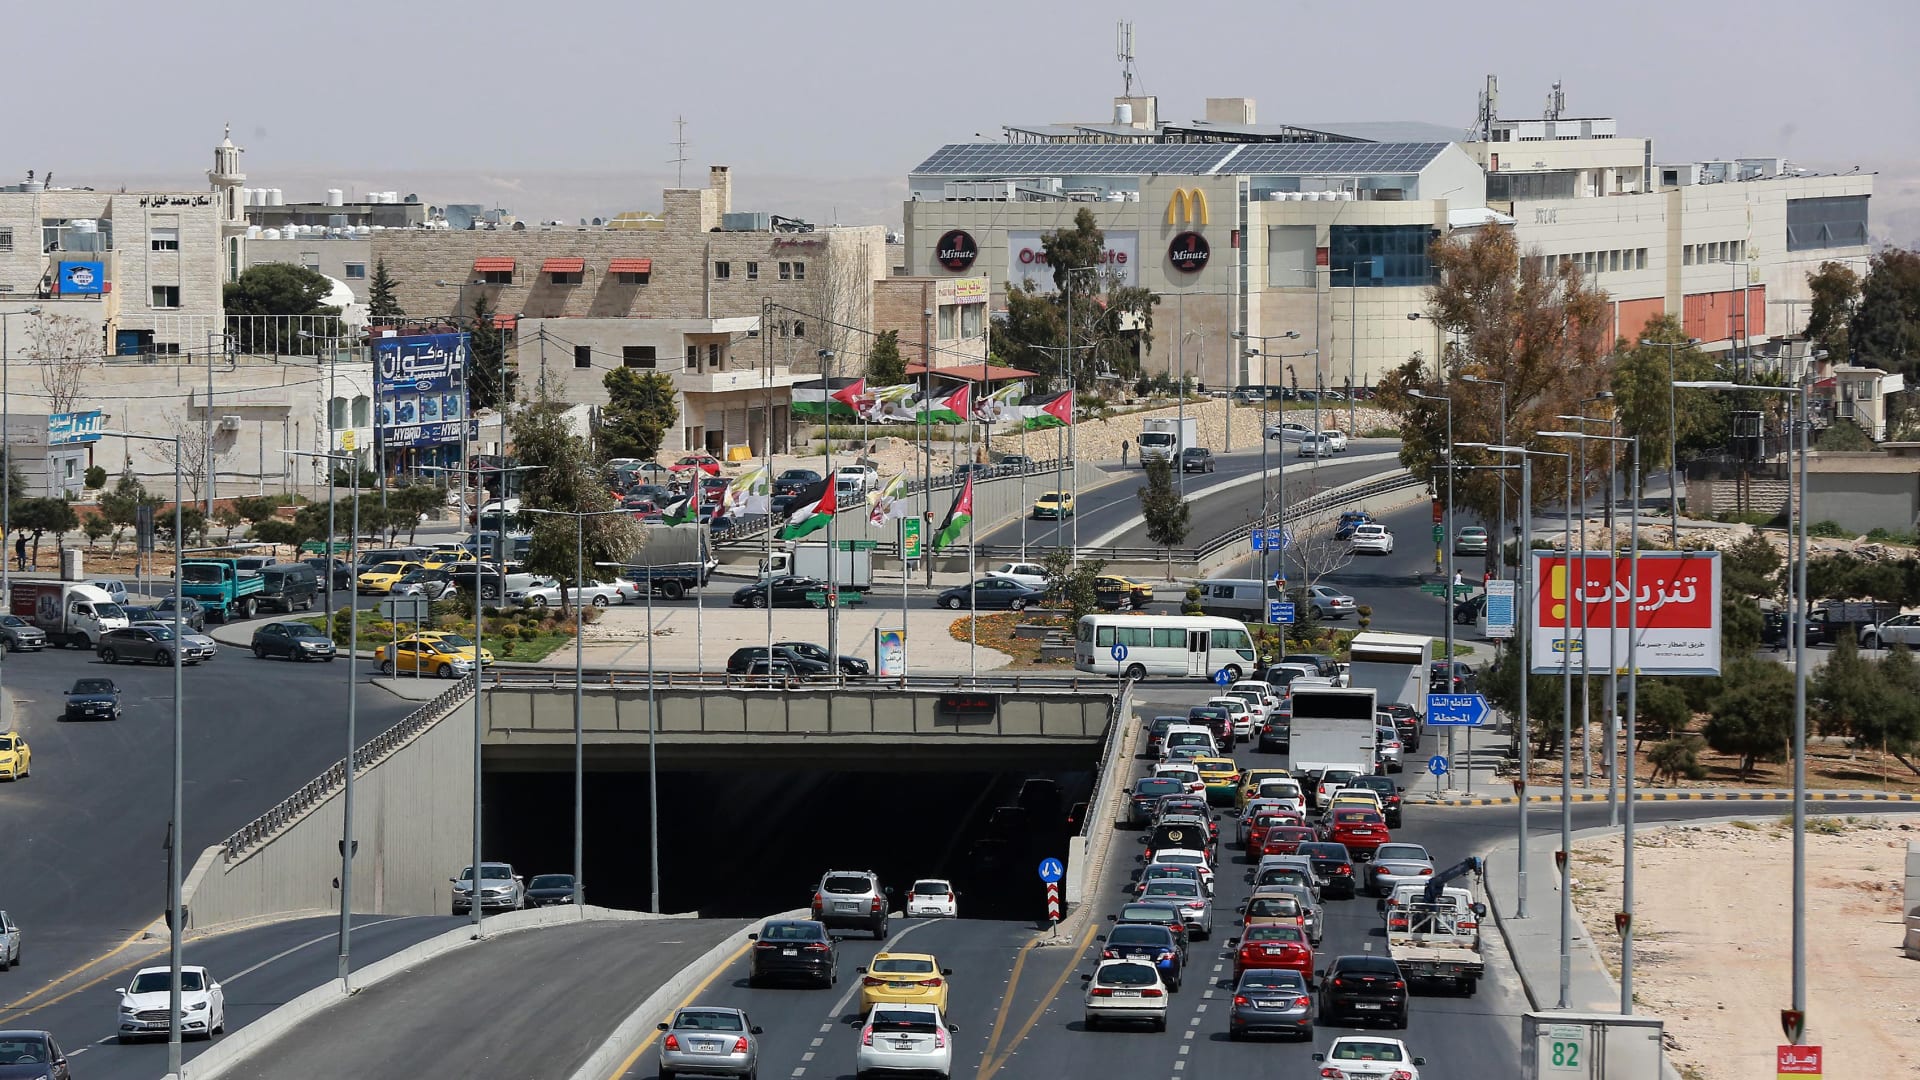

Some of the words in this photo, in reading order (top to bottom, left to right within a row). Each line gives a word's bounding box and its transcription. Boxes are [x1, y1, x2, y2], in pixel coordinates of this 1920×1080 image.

[939, 249, 975, 260] Minute
[1172, 249, 1208, 261] Minute
[393, 426, 422, 445] HYBRID
[1433, 712, 1470, 722] المحطة
[1552, 1041, 1579, 1067] 82
